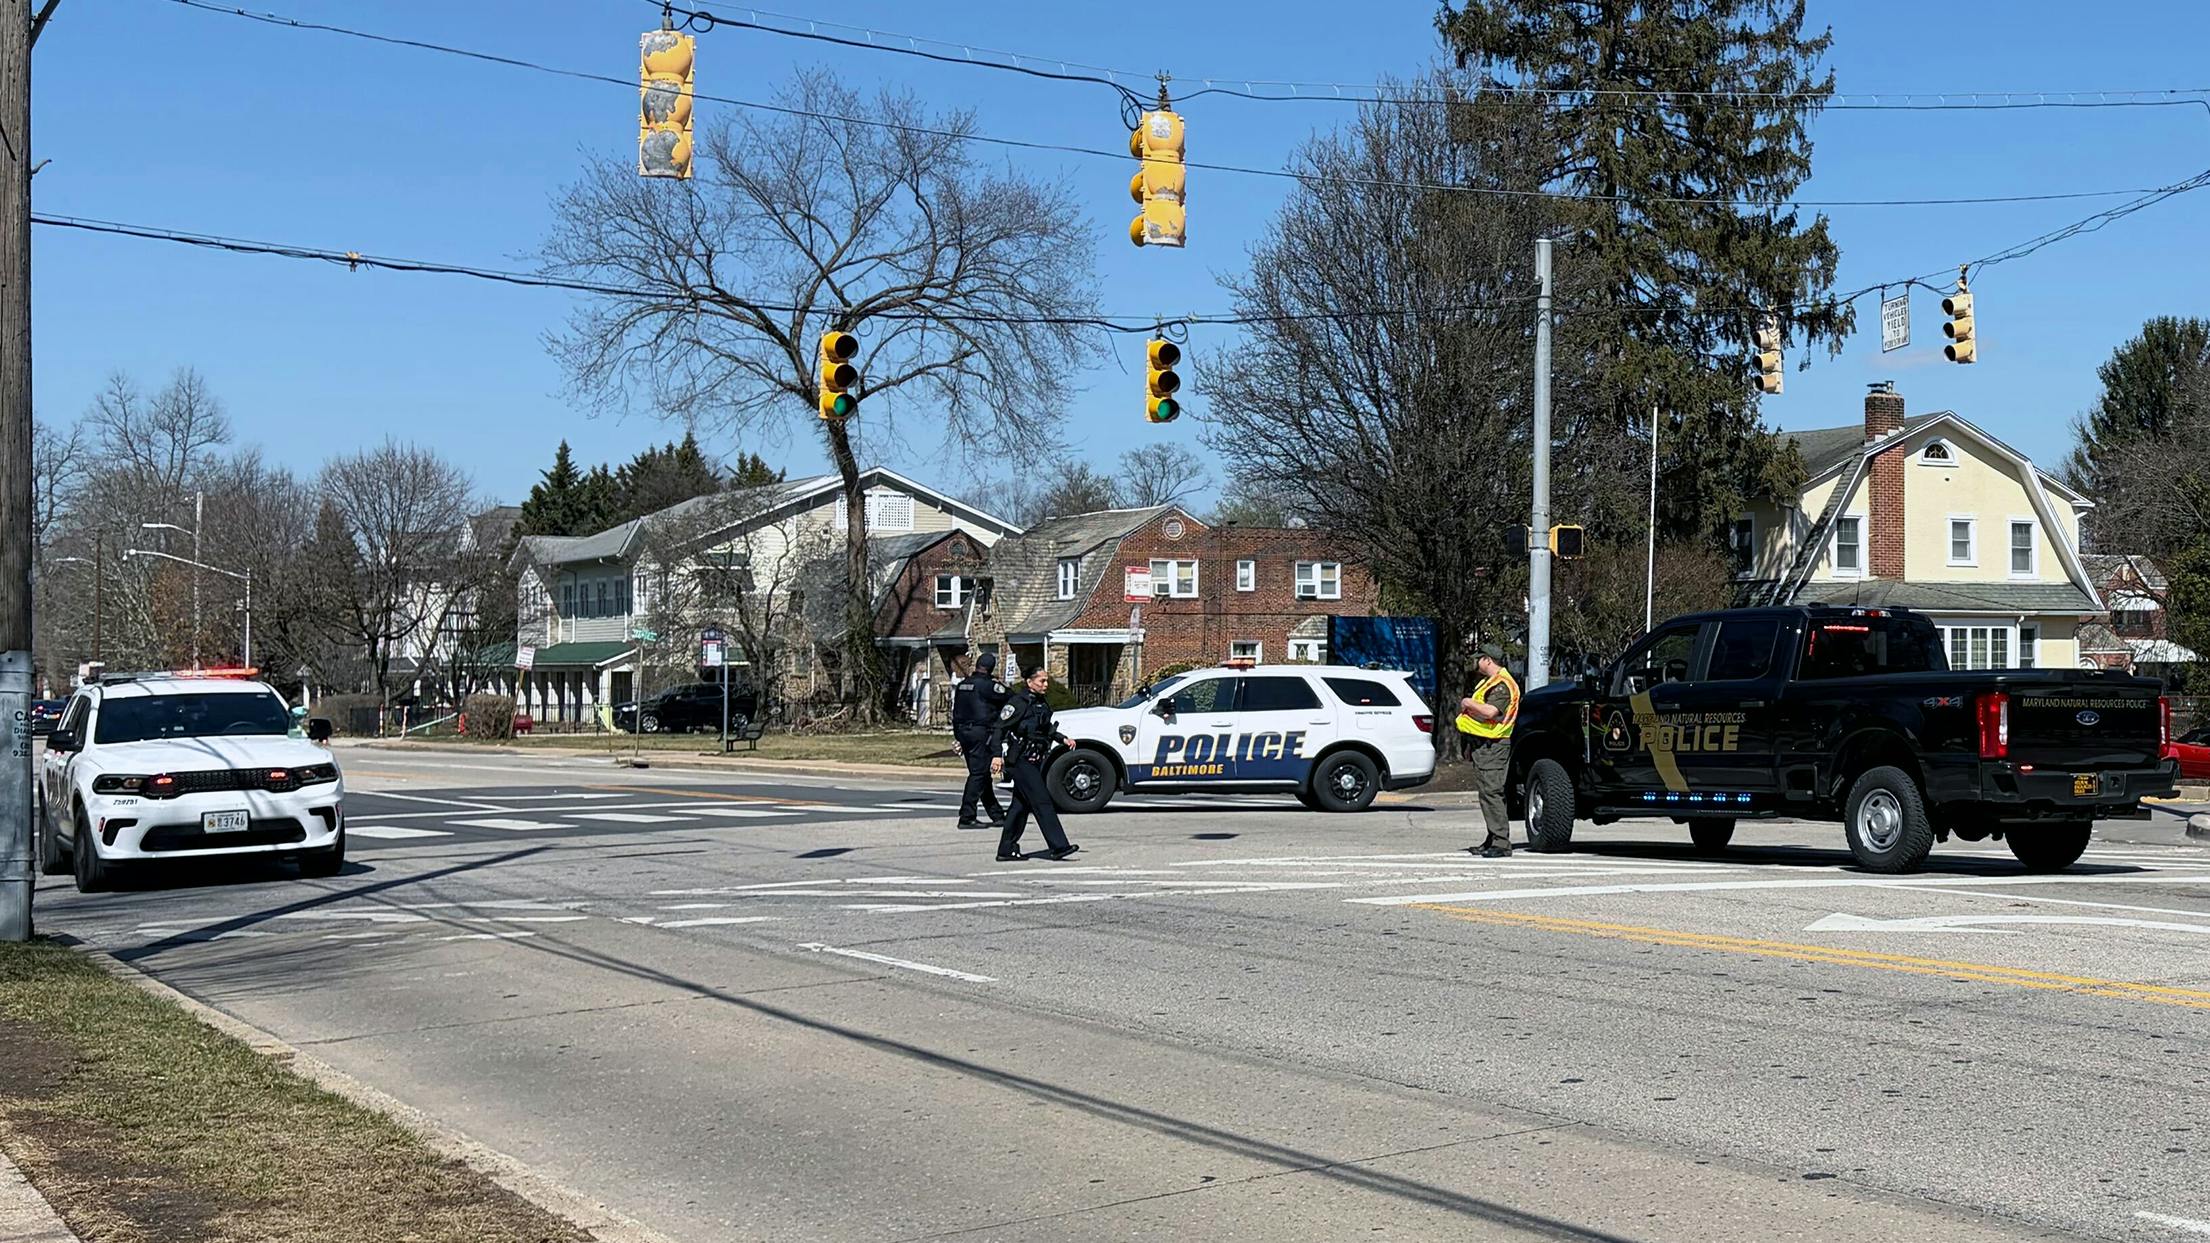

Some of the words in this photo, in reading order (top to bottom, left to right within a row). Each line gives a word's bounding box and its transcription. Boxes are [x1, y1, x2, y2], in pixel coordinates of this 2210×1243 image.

[1887, 317, 1905, 330] YIELD
[1892, 329, 1900, 337] TO
[2022, 697, 2060, 708] MARYLAND
[2061, 698, 2088, 708] NATURAL
[2090, 698, 2125, 709] RESOURCES
[2126, 699, 2146, 709] POLICE
[1632, 712, 1670, 724] MARYLAND
[1671, 712, 1703, 724] NATURAL
[1704, 712, 1746, 724] RESOURCES
[1639, 725, 1740, 751] POLICE
[1152, 730, 1307, 764] POLICE
[1151, 763, 1224, 777] BALTIMORE
